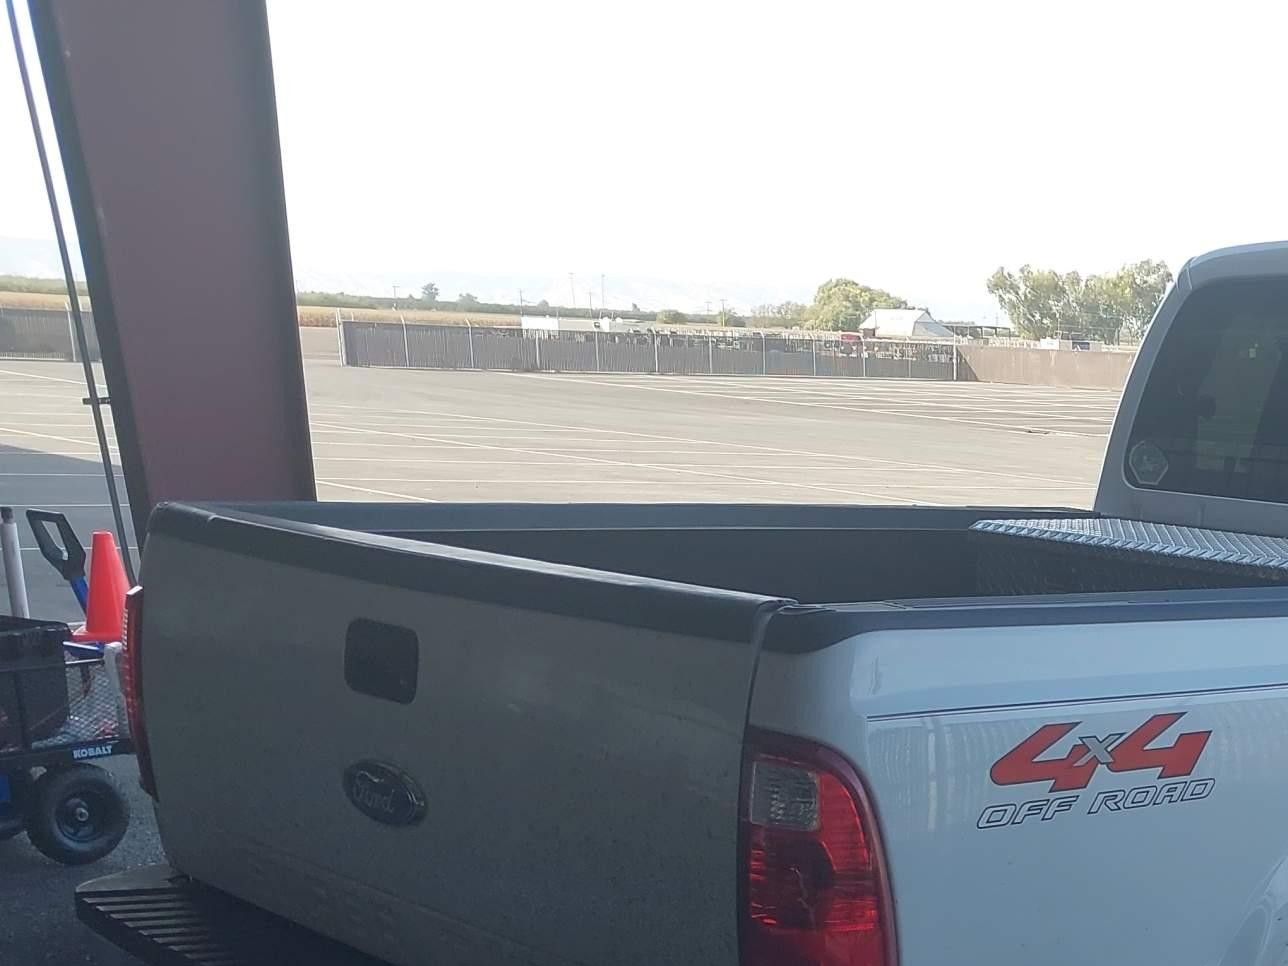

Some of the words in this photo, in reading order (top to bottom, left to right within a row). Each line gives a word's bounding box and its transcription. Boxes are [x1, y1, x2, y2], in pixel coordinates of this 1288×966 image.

[72, 745, 113, 759] KOBALT
[976, 794, 1080, 829] OFF
[1086, 777, 1216, 815] ROAD
